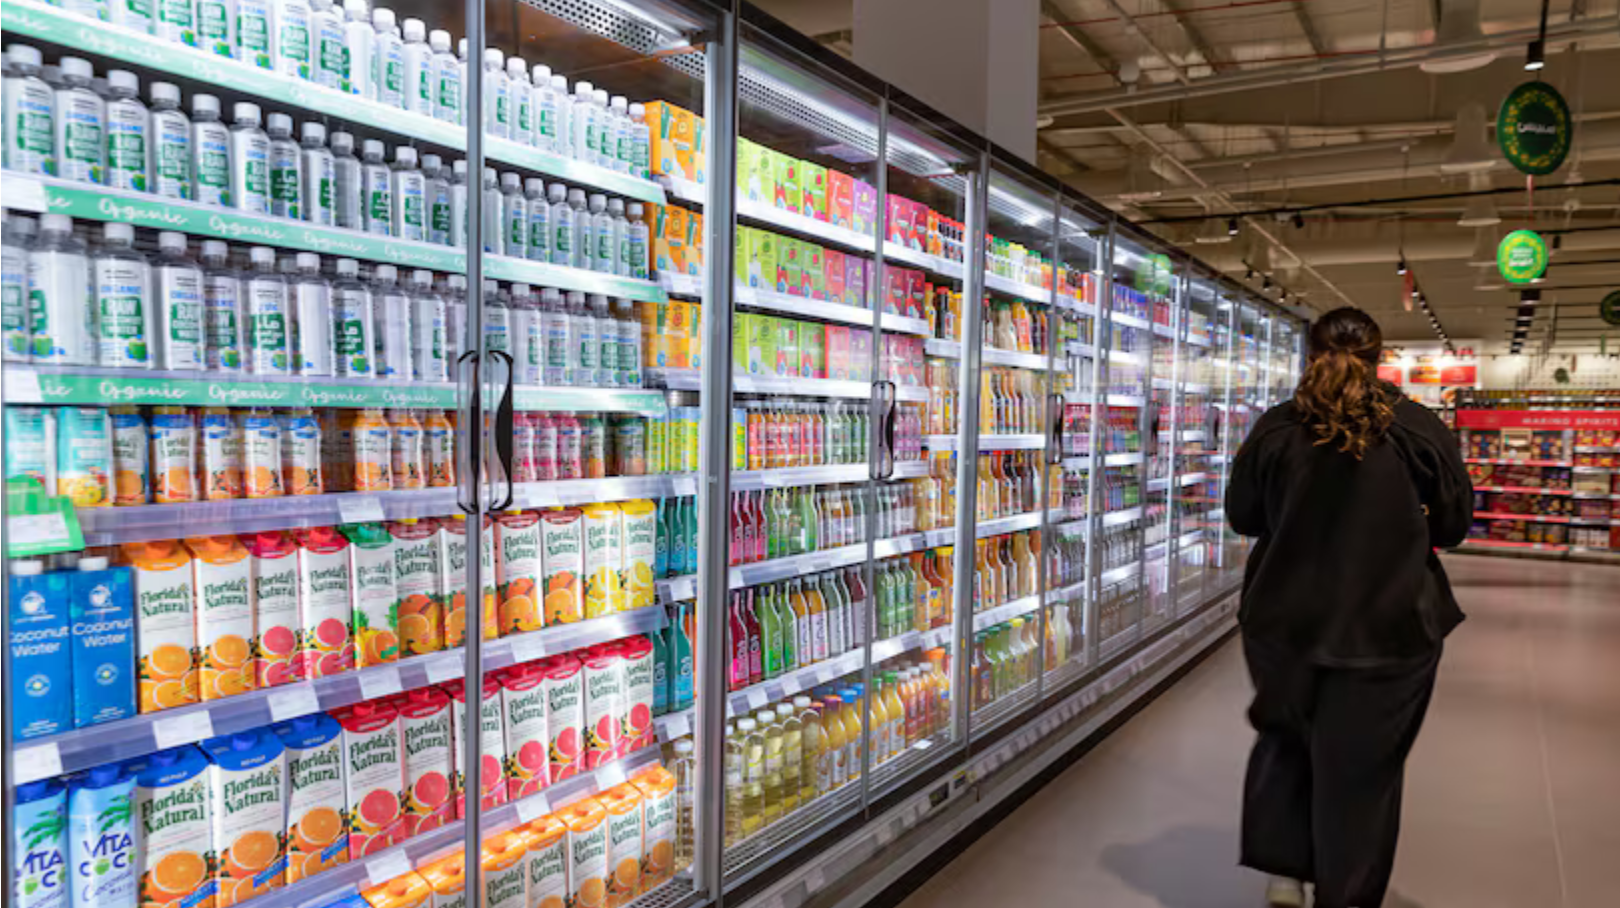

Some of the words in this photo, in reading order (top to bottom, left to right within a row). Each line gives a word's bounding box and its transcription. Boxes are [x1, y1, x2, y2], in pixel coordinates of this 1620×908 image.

[98, 198, 189, 225] Organic
[208, 214, 285, 241] Organic
[98, 380, 189, 400] Organic
[208, 383, 289, 402] Organic
[394, 545, 437, 562] Florida's
[256, 569, 296, 587] Florida's
[395, 559, 437, 577] Natural
[140, 585, 189, 602] Florida's
[204, 578, 248, 596] Florida's
[257, 584, 296, 600] Natural
[141, 601, 189, 619] Natural
[204, 594, 248, 611] Natural
[12, 642, 61, 657] Water
[82, 633, 125, 647] Water
[548, 679, 579, 699] Florida's
[508, 689, 545, 713] Florida's
[549, 690, 578, 711] Natural
[510, 707, 544, 727] Natural
[405, 718, 449, 742] Florida's
[350, 732, 397, 760] Florida's
[406, 733, 449, 756] Natural
[289, 750, 340, 779] Florida's
[351, 750, 397, 772] Natural
[223, 770, 280, 800] Florida's
[290, 767, 340, 791] Natural
[140, 783, 205, 818] Florida's
[223, 789, 280, 818] Natural
[141, 805, 205, 835] Natural
[83, 832, 133, 858] VITA
[530, 844, 565, 873] Florida's
[486, 862, 524, 890] Florida's
[531, 862, 565, 884] Natural
[487, 883, 524, 906] Natural
